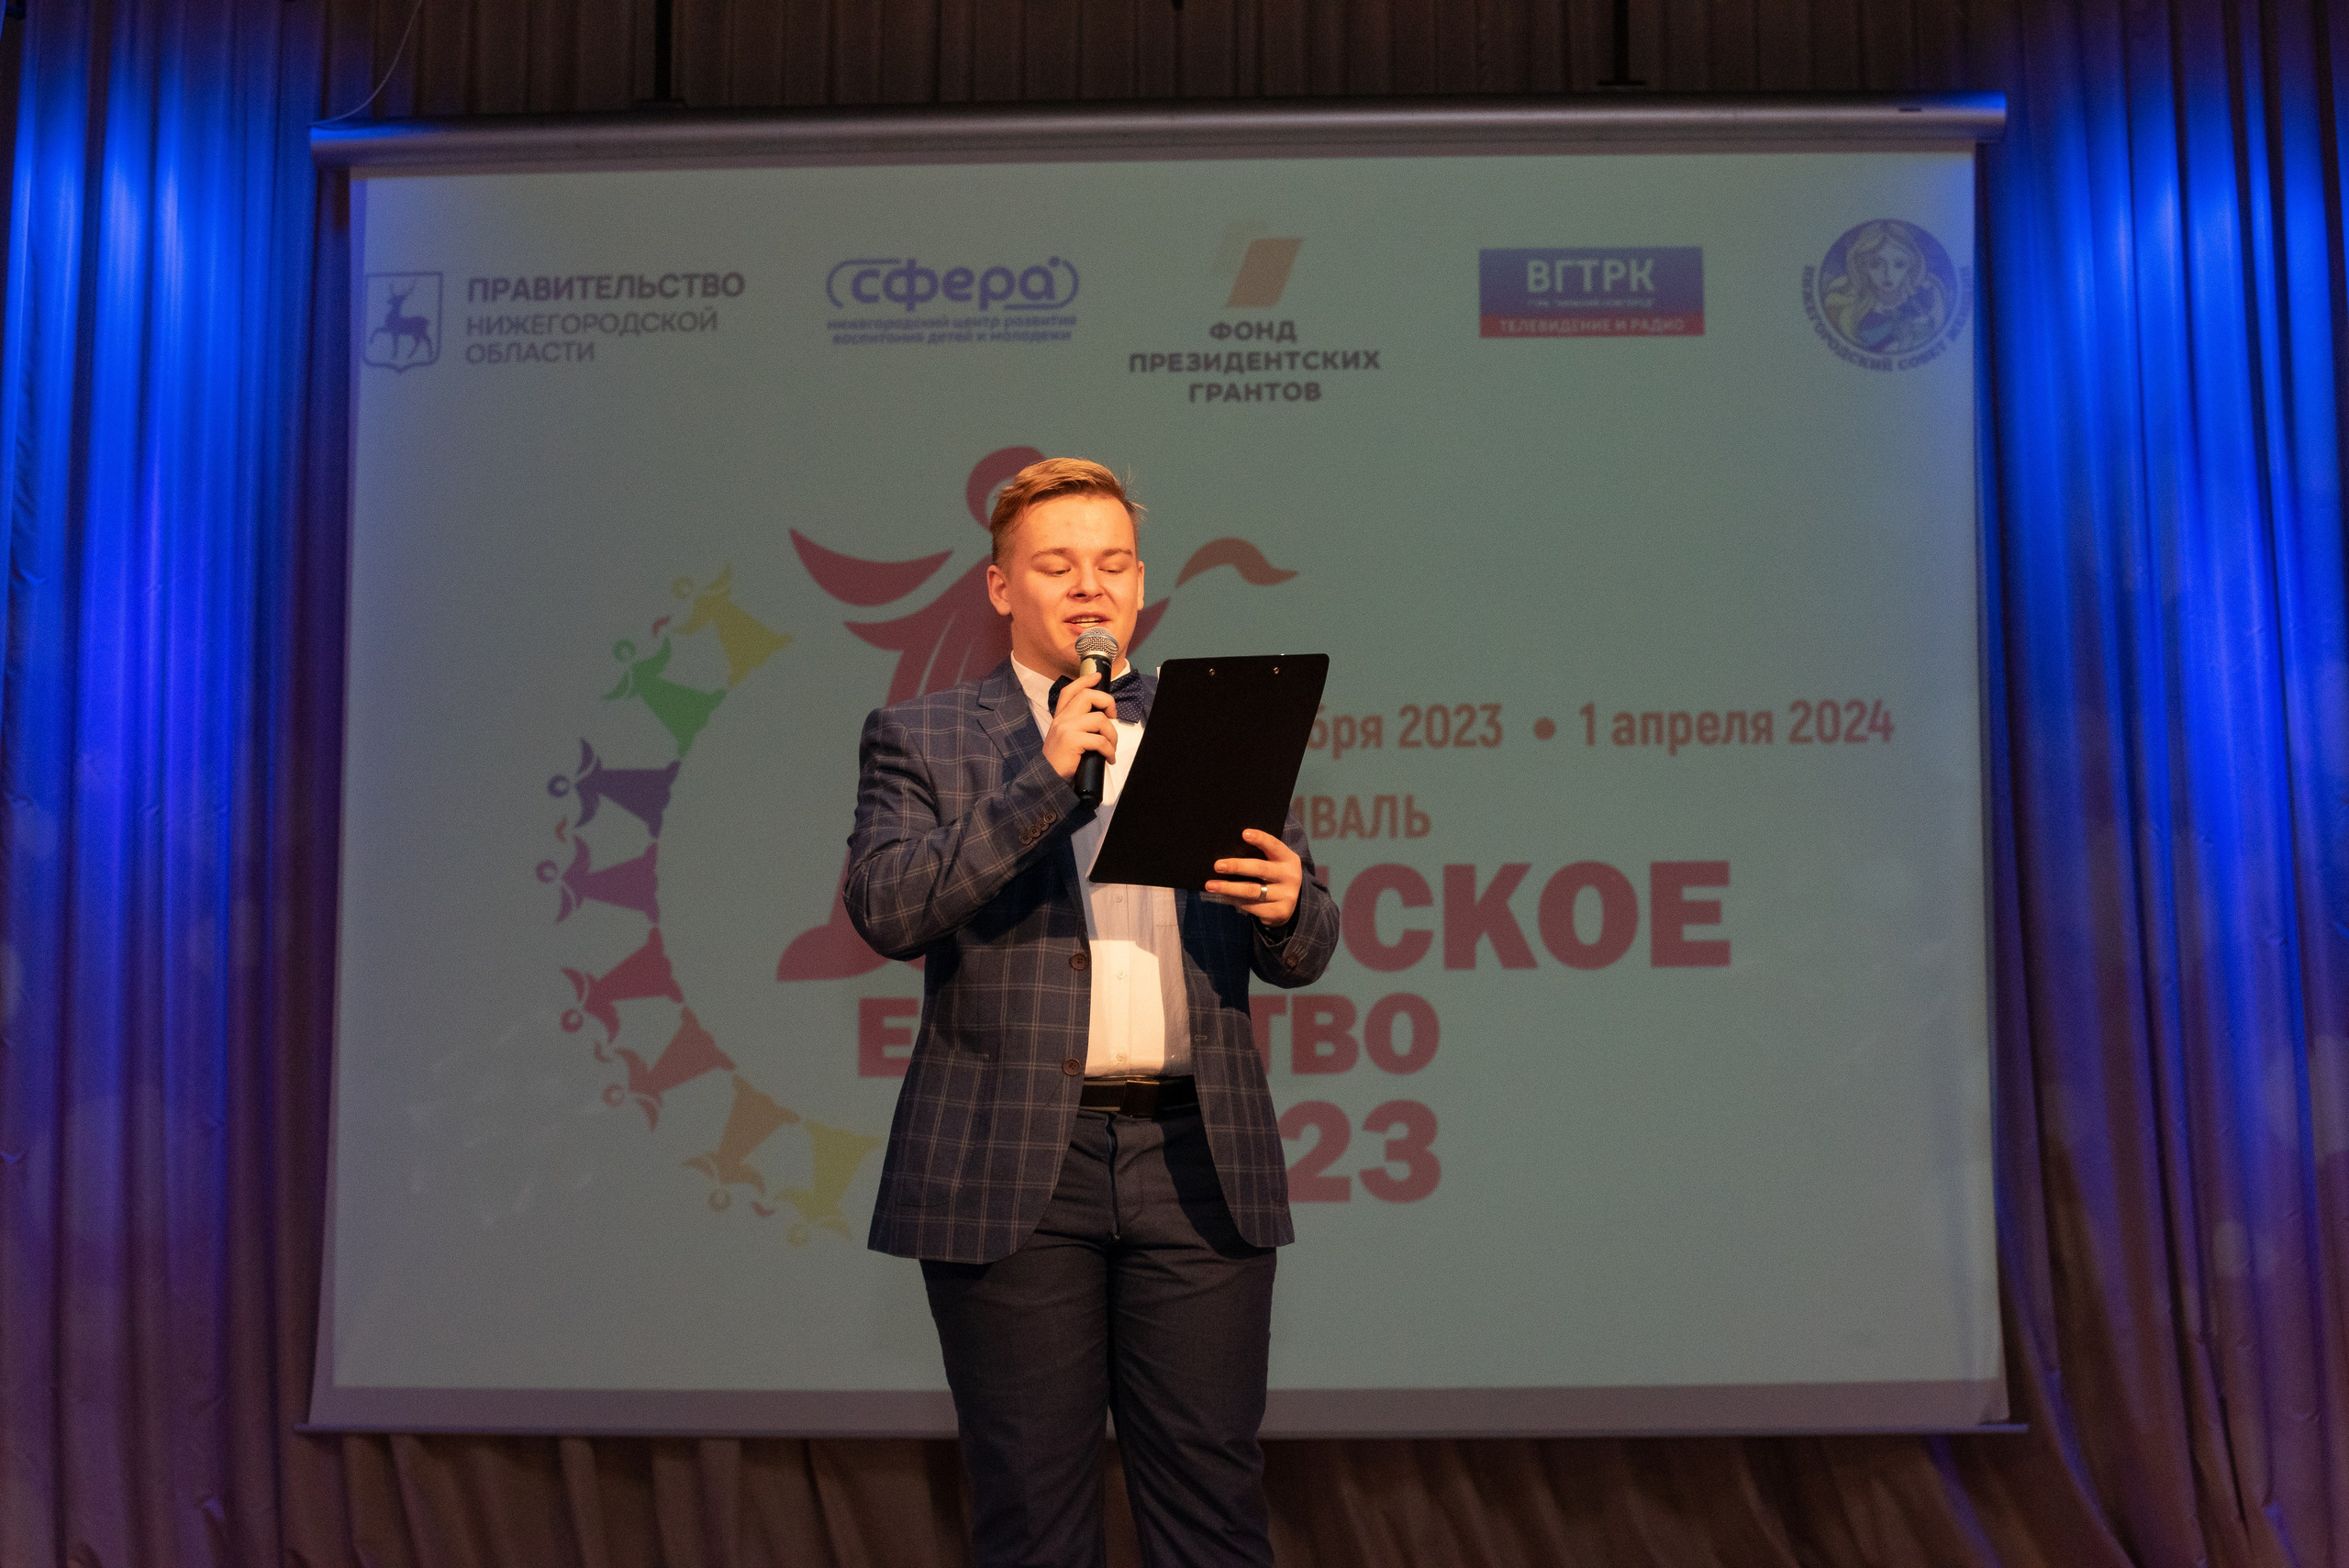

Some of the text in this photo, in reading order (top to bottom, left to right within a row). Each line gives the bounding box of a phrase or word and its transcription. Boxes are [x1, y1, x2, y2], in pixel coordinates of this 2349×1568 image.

[467, 271, 746, 304] ПРАВИТЕЛЬСТВО
[851, 258, 1056, 313] сфера
[1526, 258, 1655, 294] ВГТРК
[465, 307, 718, 337] НИЖЕГОРОДСКОЙ
[1208, 320, 1298, 344] ФОНД
[1499, 317, 1686, 334] ТЕЛЕВИДЕНИЕ И РАДИО
[464, 339, 596, 366] ОБЛАСТИ
[1129, 350, 1381, 374] ПРЕЗИДЕНТСКИХ
[1188, 381, 1323, 404] ГРАНТОВ
[1397, 703, 1503, 750] 2023
[1578, 702, 1597, 747] 1
[1611, 708, 1775, 756] апреля
[1788, 698, 1896, 745] 2024
[1315, 860, 1732, 973] СКОЕ
